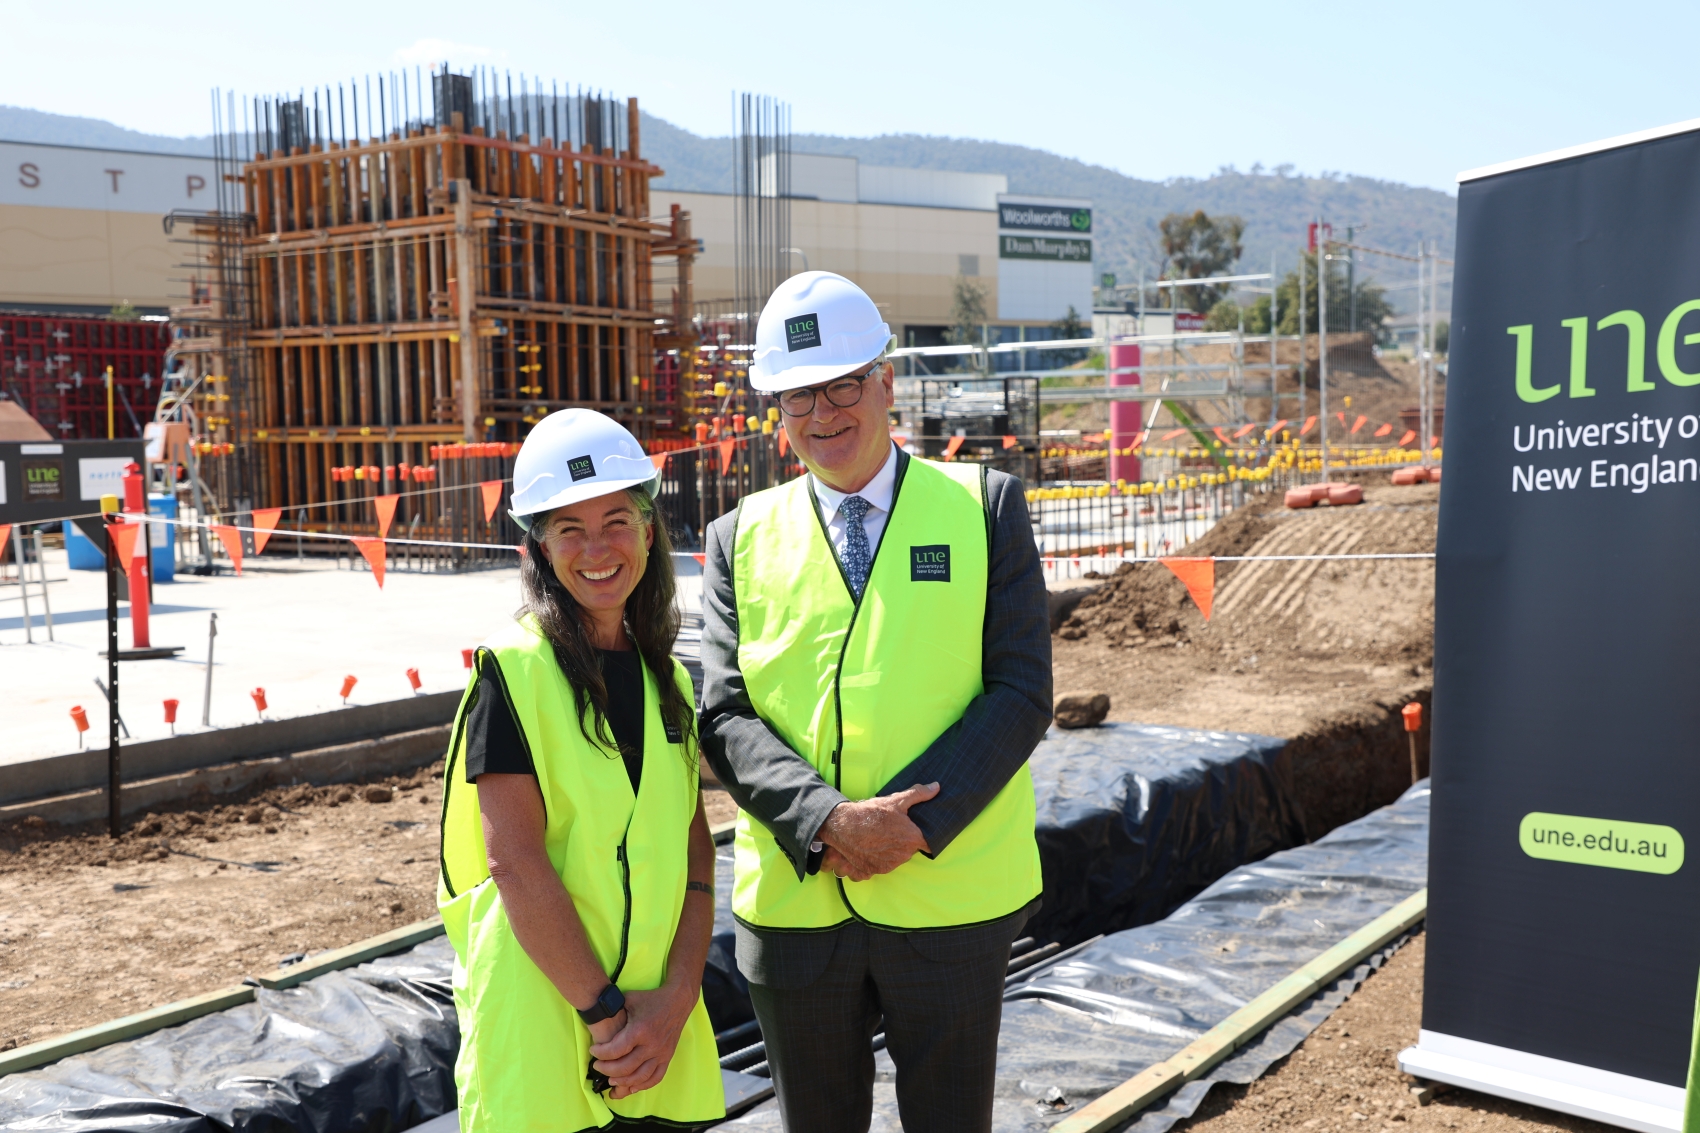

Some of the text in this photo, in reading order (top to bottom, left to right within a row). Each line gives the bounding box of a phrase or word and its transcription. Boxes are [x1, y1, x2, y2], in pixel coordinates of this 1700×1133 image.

[1002, 208, 1071, 228] Woolworths
[1005, 237, 1088, 259] Dan Murphy's
[788, 320, 815, 334] une
[791, 332, 810, 340] University
[800, 335, 816, 343] England
[1507, 299, 1700, 403] une
[1513, 413, 1700, 452] University o
[570, 459, 590, 471] une
[27, 467, 60, 482] une
[1512, 454, 1700, 494] New Englan
[915, 551, 946, 563] une
[1533, 828, 1668, 858] une.edu.au
